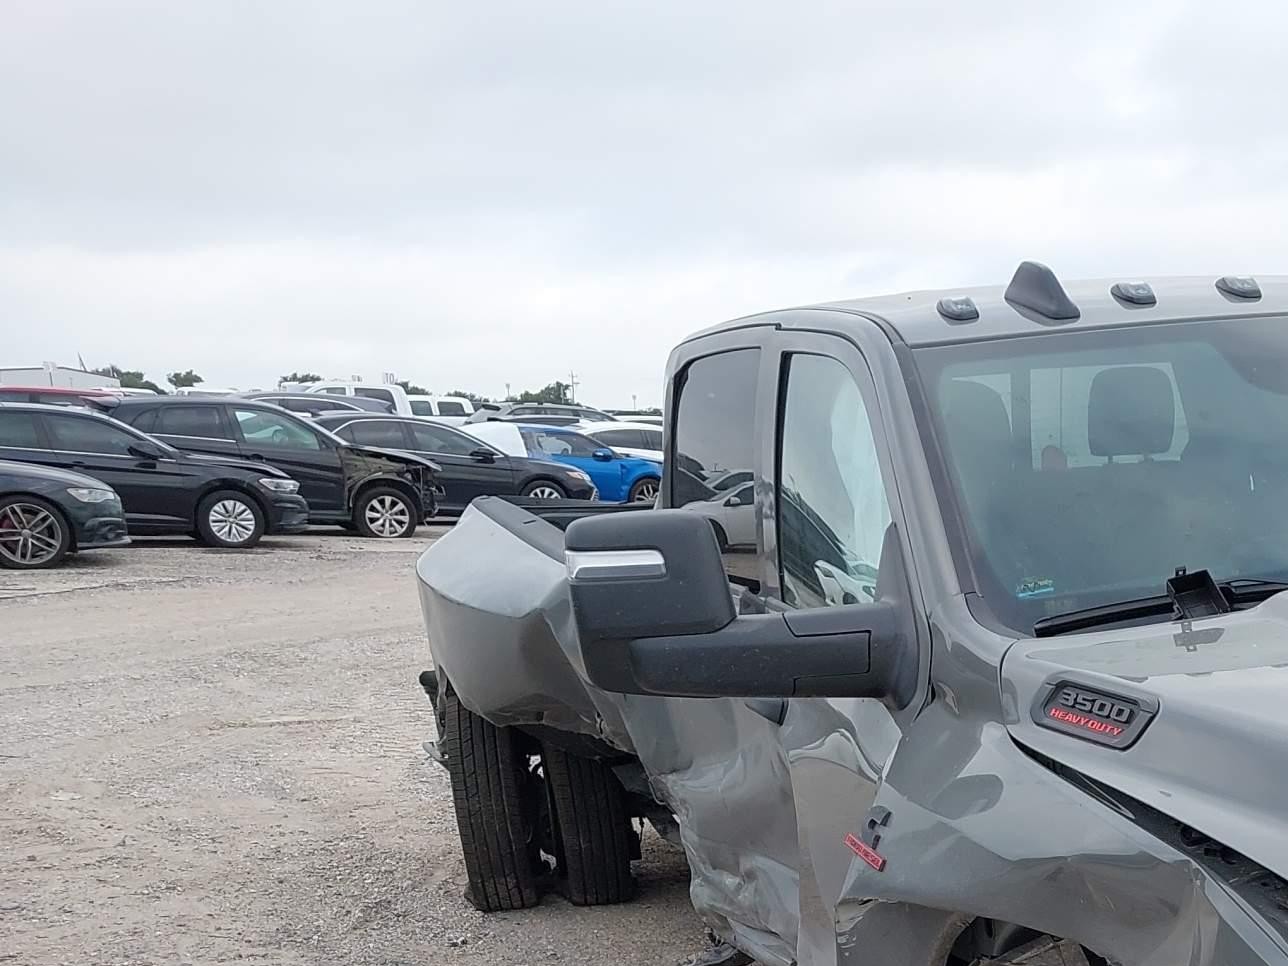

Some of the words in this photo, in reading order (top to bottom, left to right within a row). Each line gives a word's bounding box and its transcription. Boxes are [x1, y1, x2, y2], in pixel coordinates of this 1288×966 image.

[1059, 689, 1131, 723] 3500
[1050, 708, 1090, 726] HEAVY
[1087, 720, 1123, 736] DUTY
